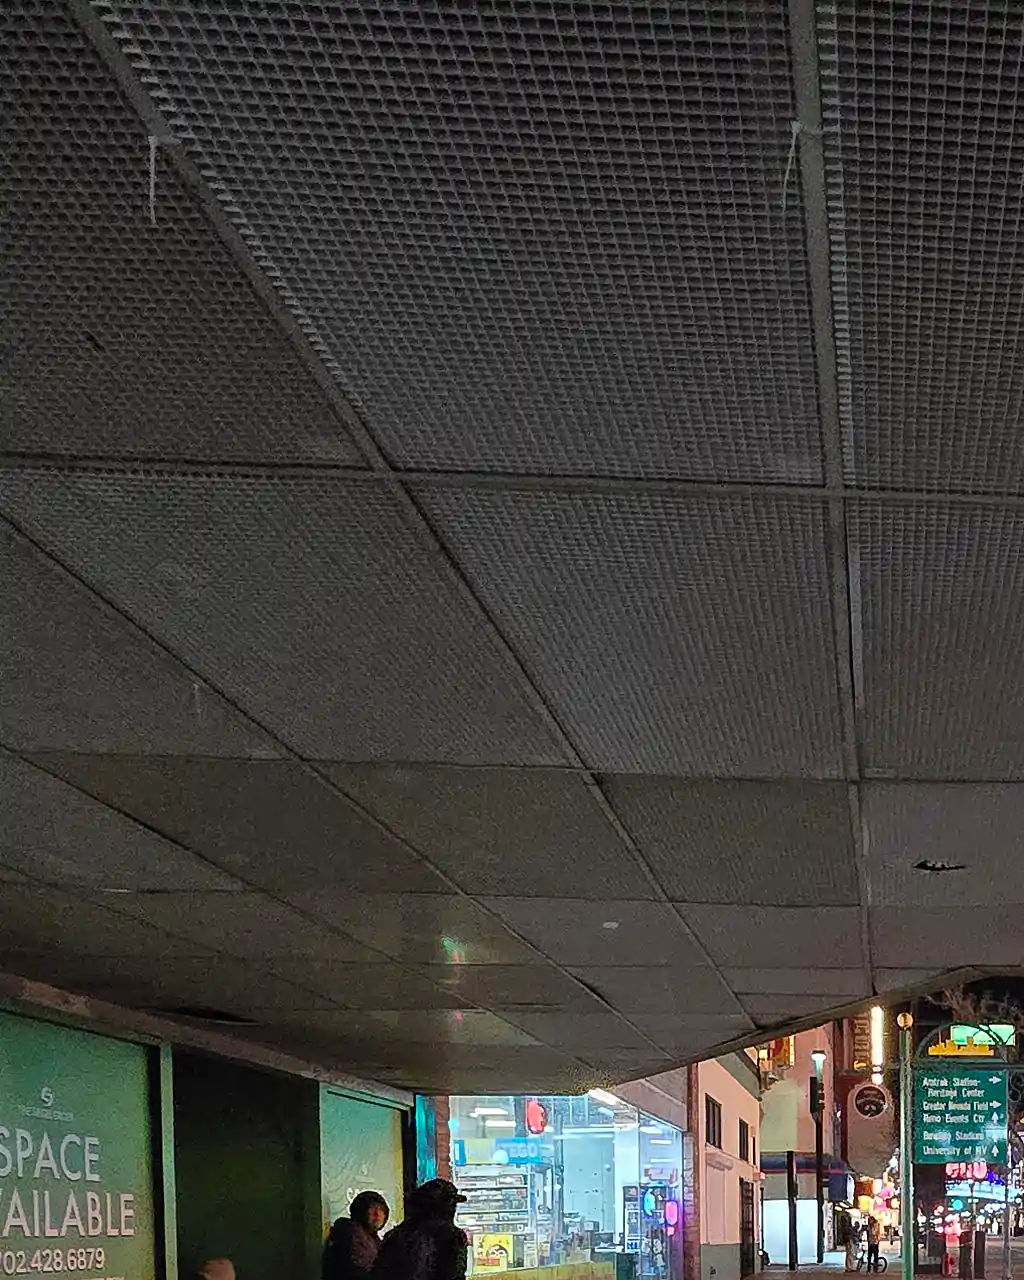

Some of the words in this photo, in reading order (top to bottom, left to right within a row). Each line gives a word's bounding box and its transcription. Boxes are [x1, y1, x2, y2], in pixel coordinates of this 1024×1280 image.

[961, 1088, 985, 1097] Center
[945, 1113, 970, 1123] Events
[973, 1113, 986, 1123] Ctr
[0, 1125, 102, 1182] SPACE
[922, 1146, 960, 1157] University
[964, 1146, 973, 1155] of
[0, 1187, 135, 1238] AILABLE
[0, 1247, 106, 1275] 02.428.6879
